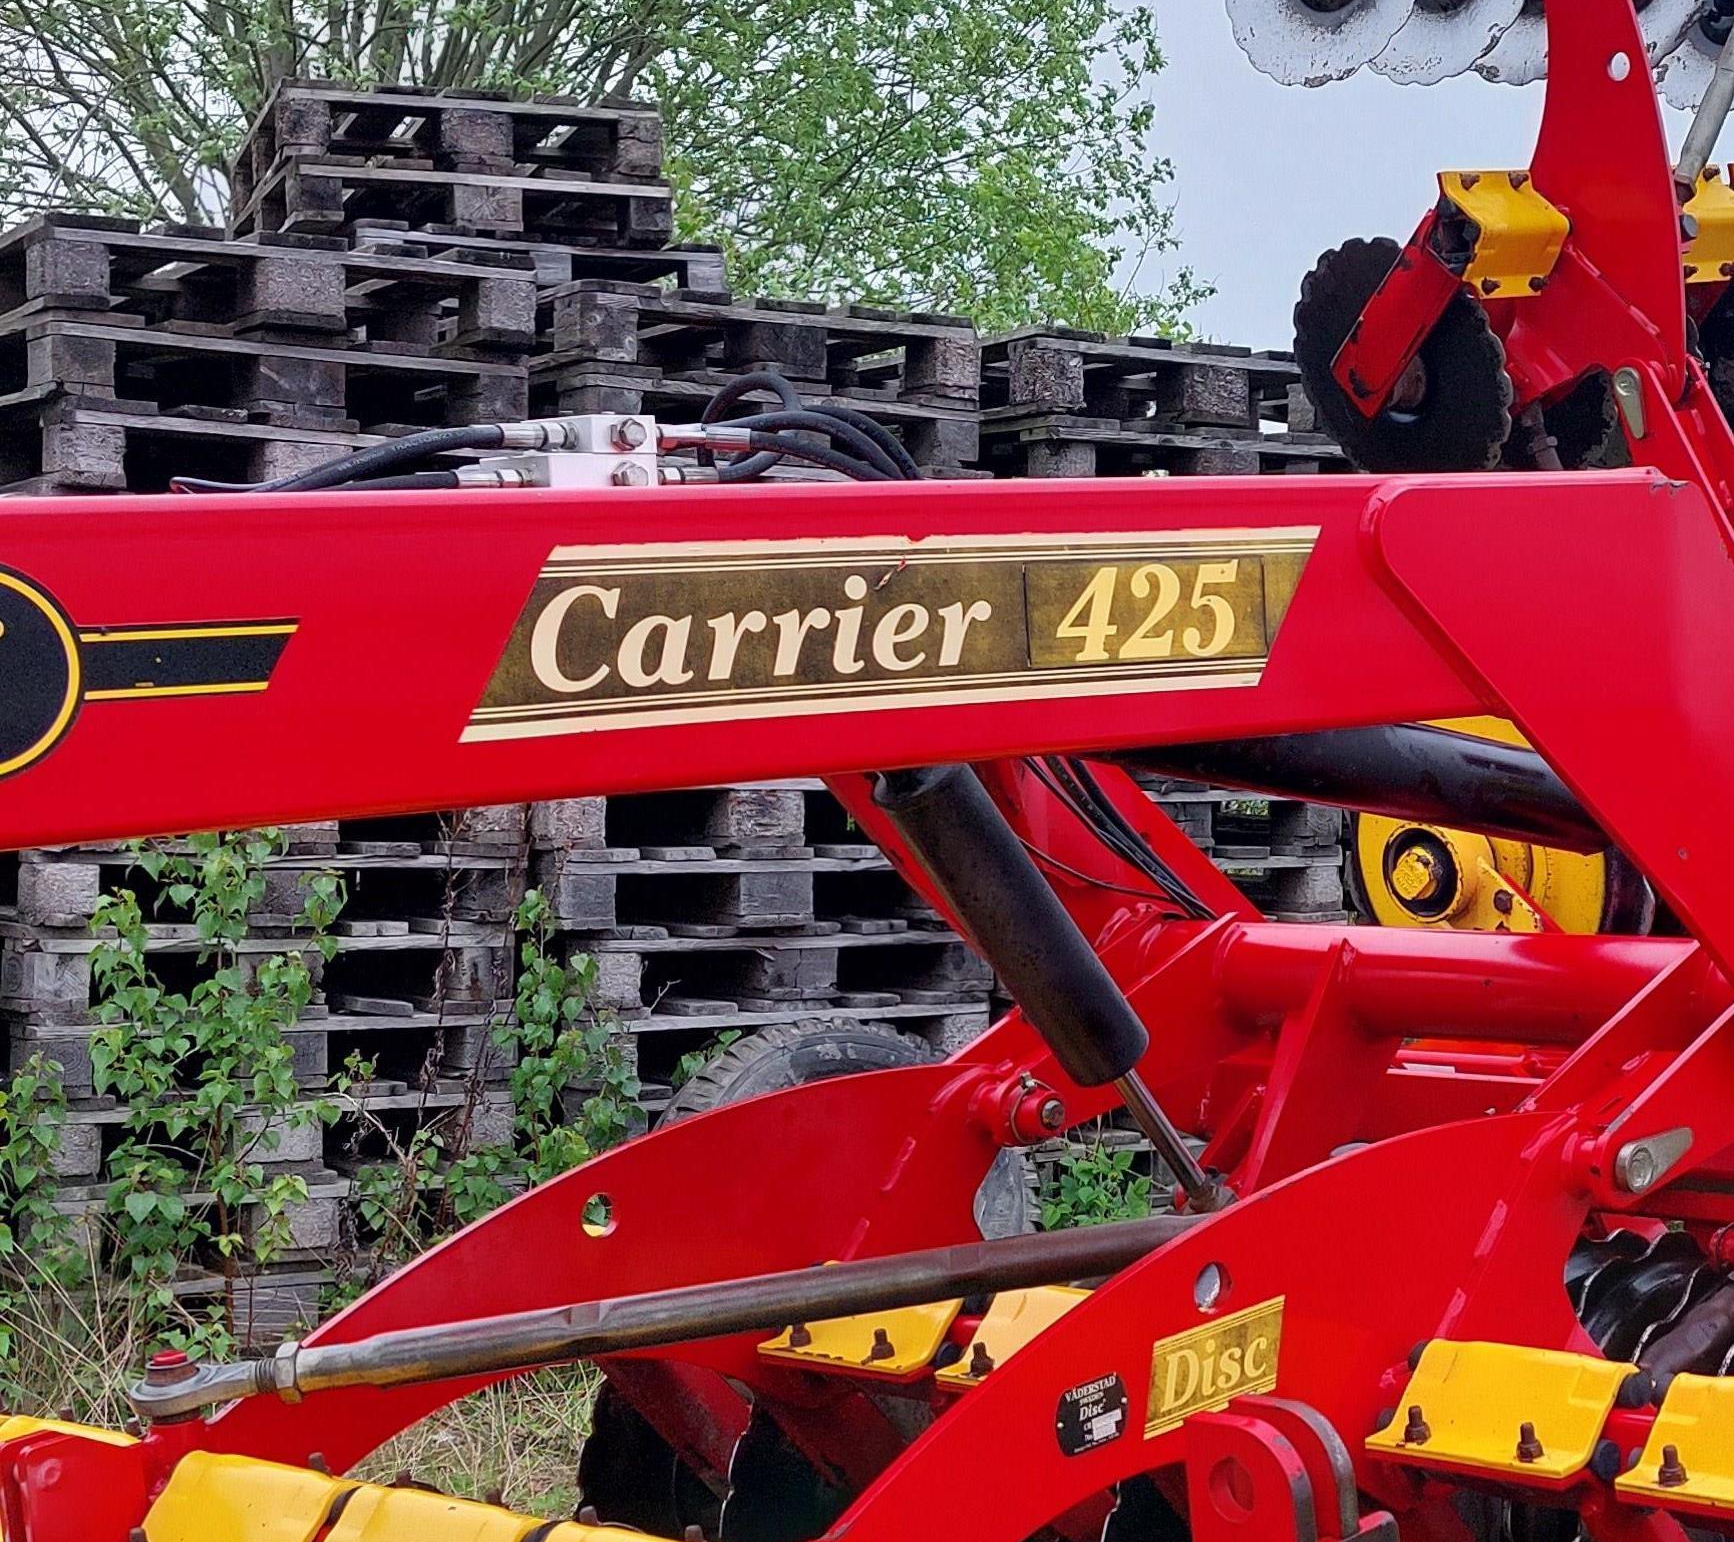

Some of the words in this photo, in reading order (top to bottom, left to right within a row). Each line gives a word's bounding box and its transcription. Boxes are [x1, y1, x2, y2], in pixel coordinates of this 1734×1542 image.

[529, 574, 992, 693] Carrier
[1055, 558, 1240, 661] 425
[1160, 1337, 1268, 1414] Disc
